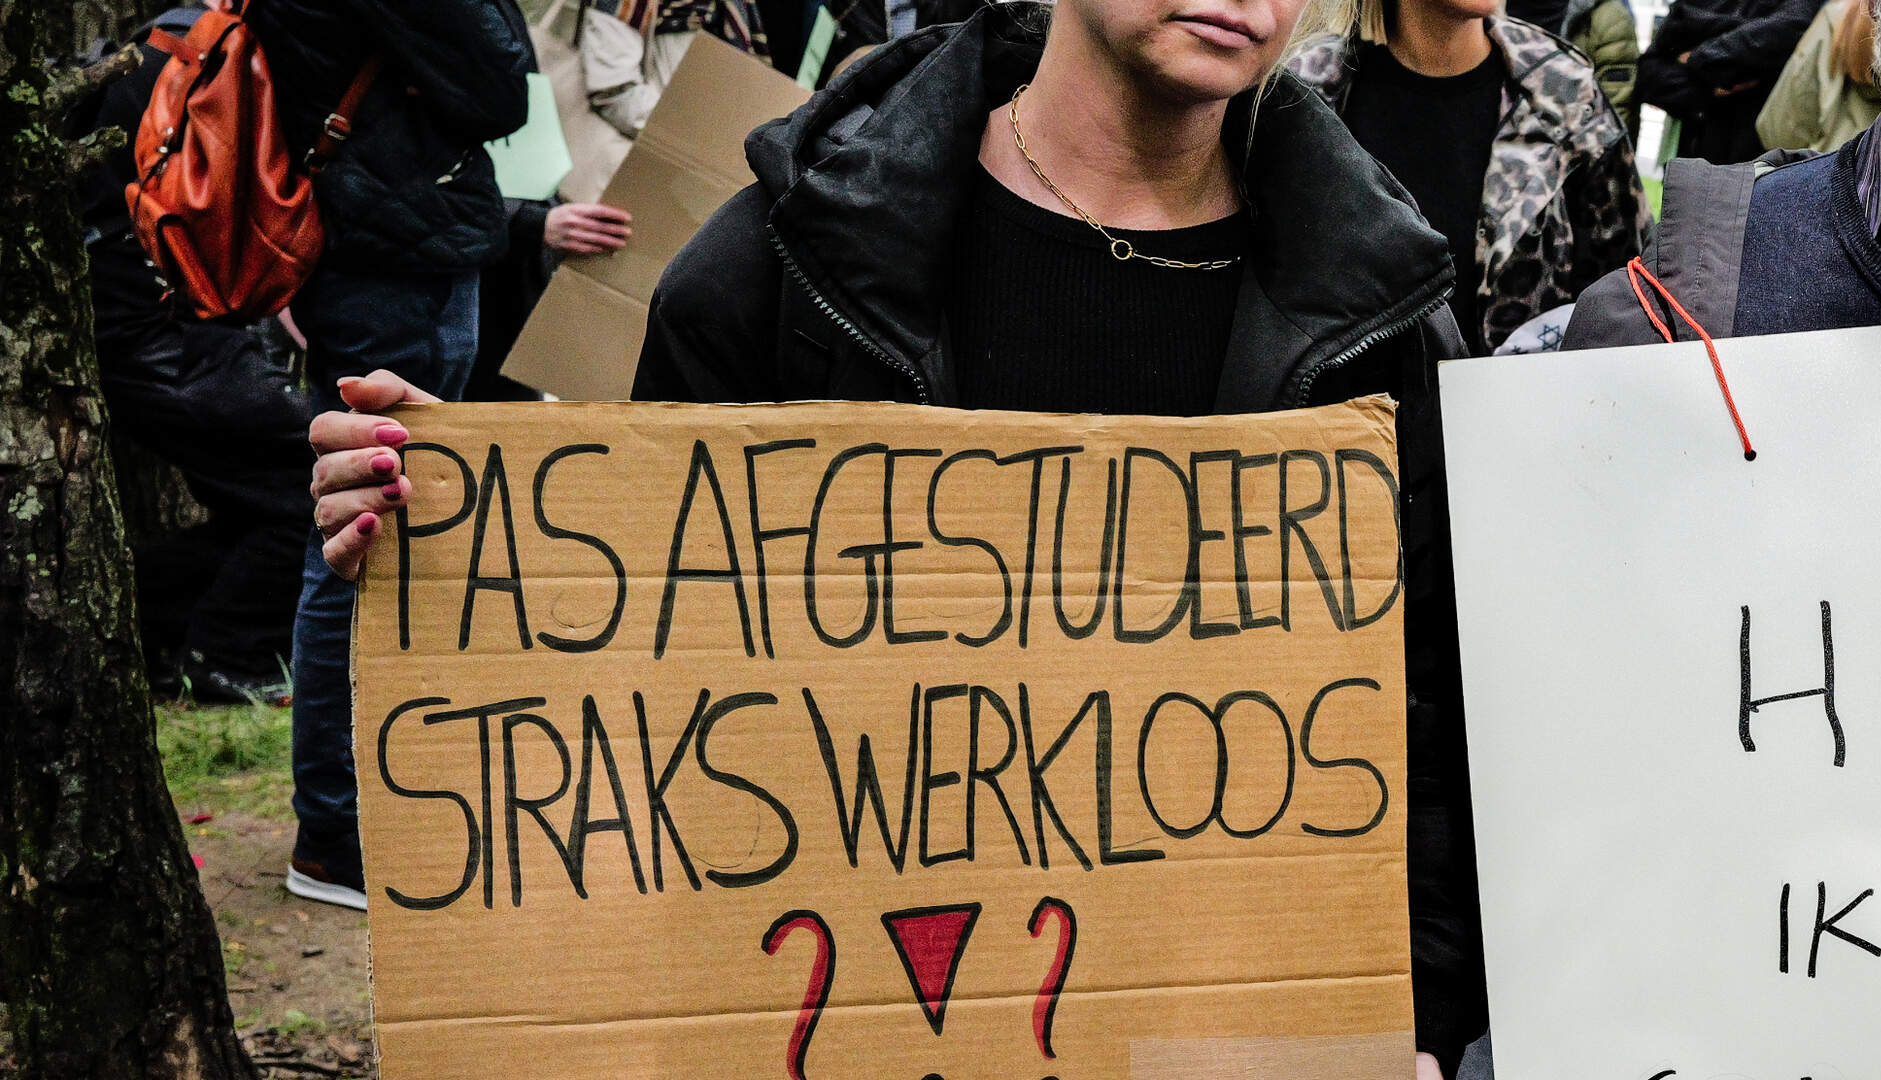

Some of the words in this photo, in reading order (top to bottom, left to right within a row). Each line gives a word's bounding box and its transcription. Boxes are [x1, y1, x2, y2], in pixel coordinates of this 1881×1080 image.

[397, 439, 628, 655] PAS
[654, 437, 1402, 660] AFGESTUDEERD
[377, 687, 800, 911] STRAKS
[801, 676, 1390, 876] WERKLOOS
